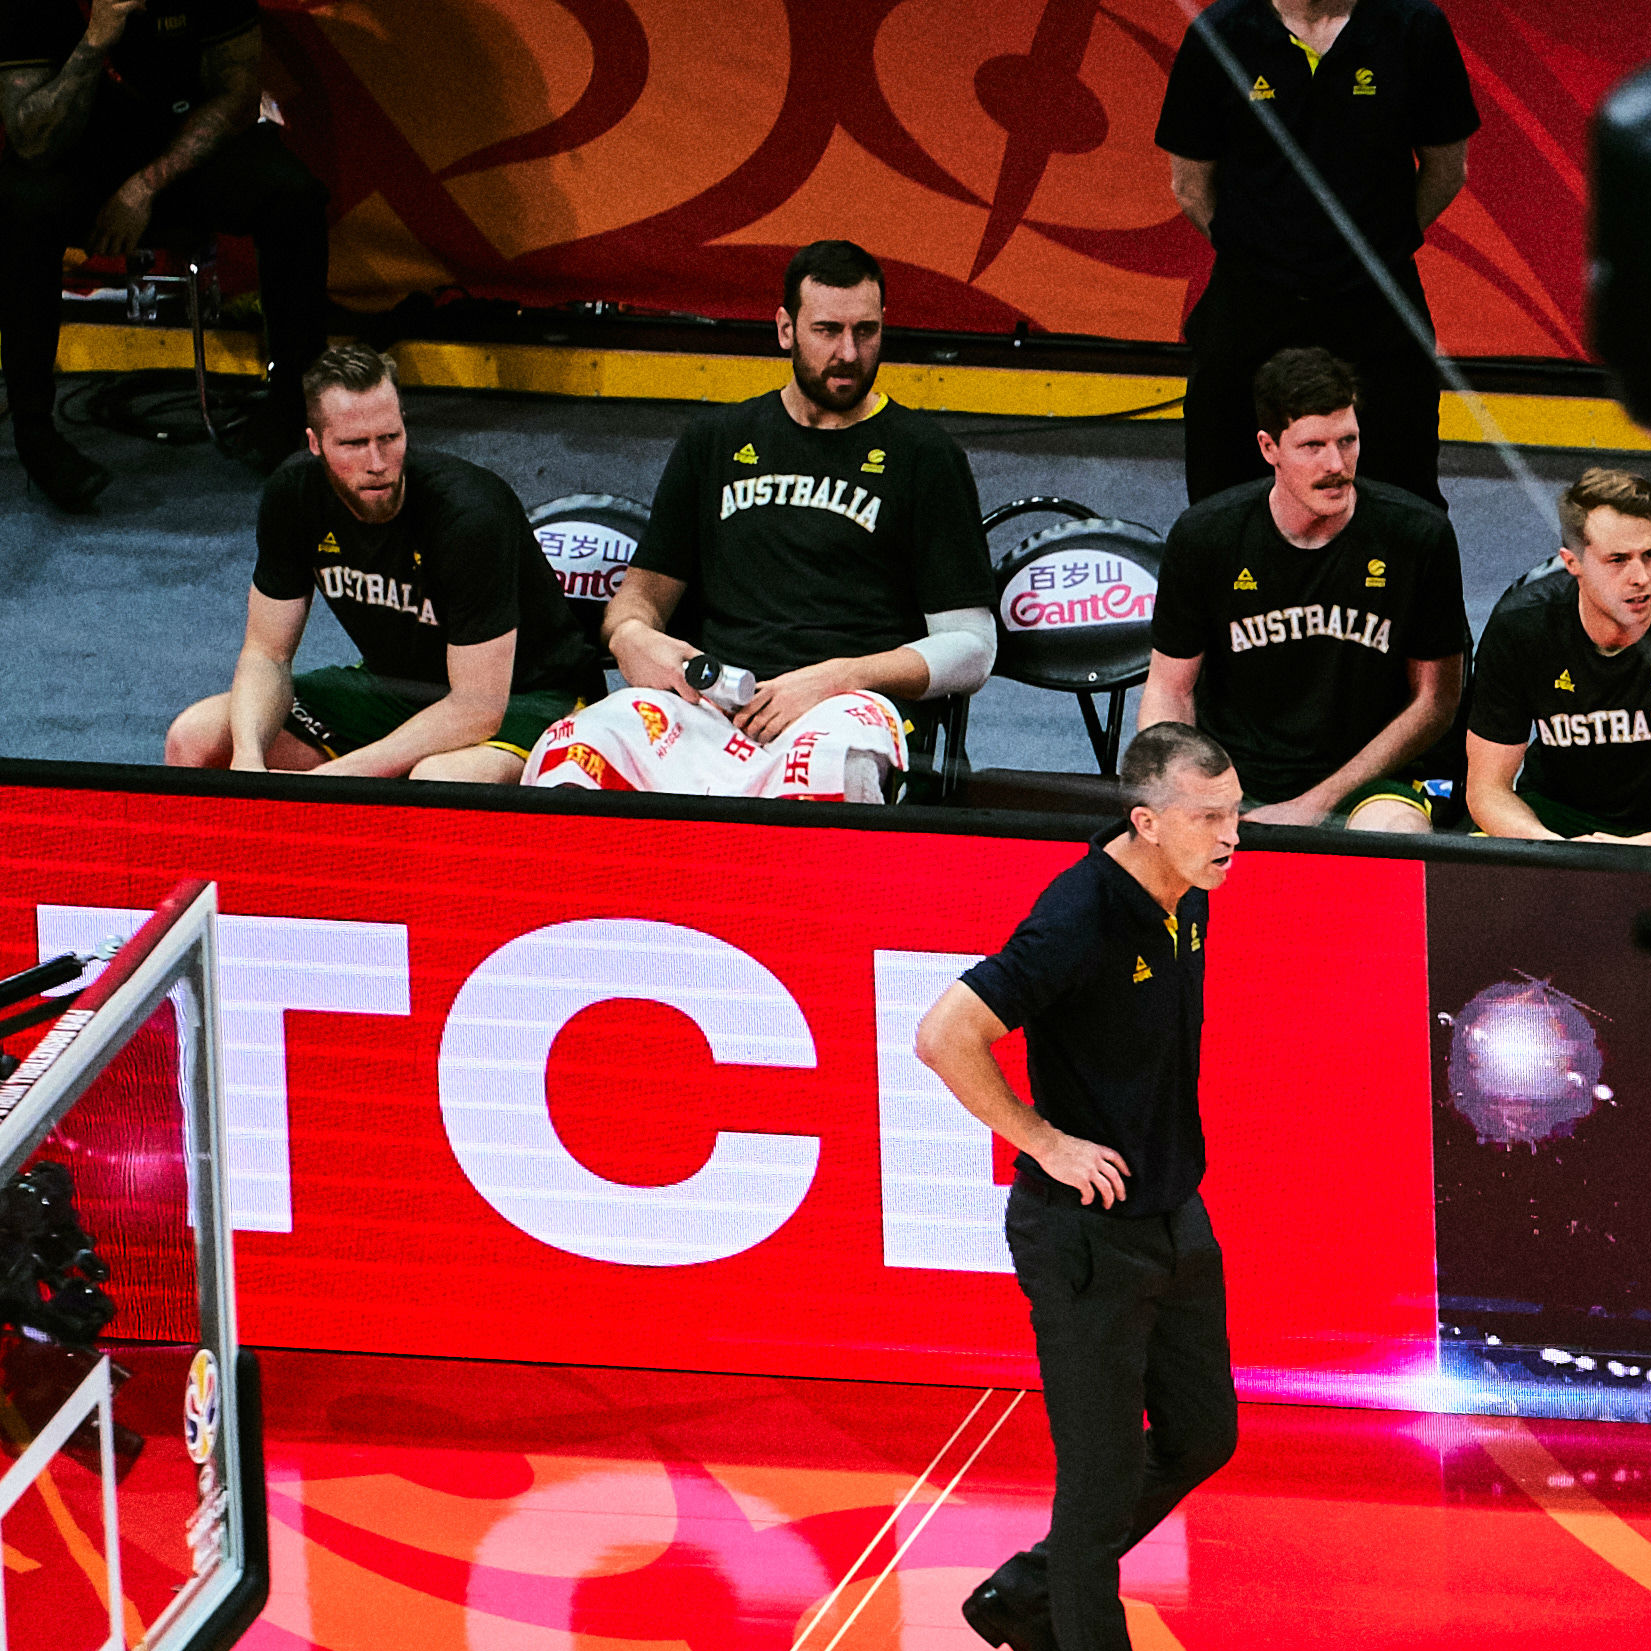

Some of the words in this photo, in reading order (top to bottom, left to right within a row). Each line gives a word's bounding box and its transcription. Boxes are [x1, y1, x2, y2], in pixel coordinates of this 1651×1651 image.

[720, 474, 882, 533] AUSTRALIA
[540, 531, 631, 564] 百岁山
[314, 565, 439, 627] USTRALA
[1028, 560, 1123, 591] 百岁山
[1229, 604, 1392, 654] AUSTRALIA
[36, 903, 1018, 1274] TCL
